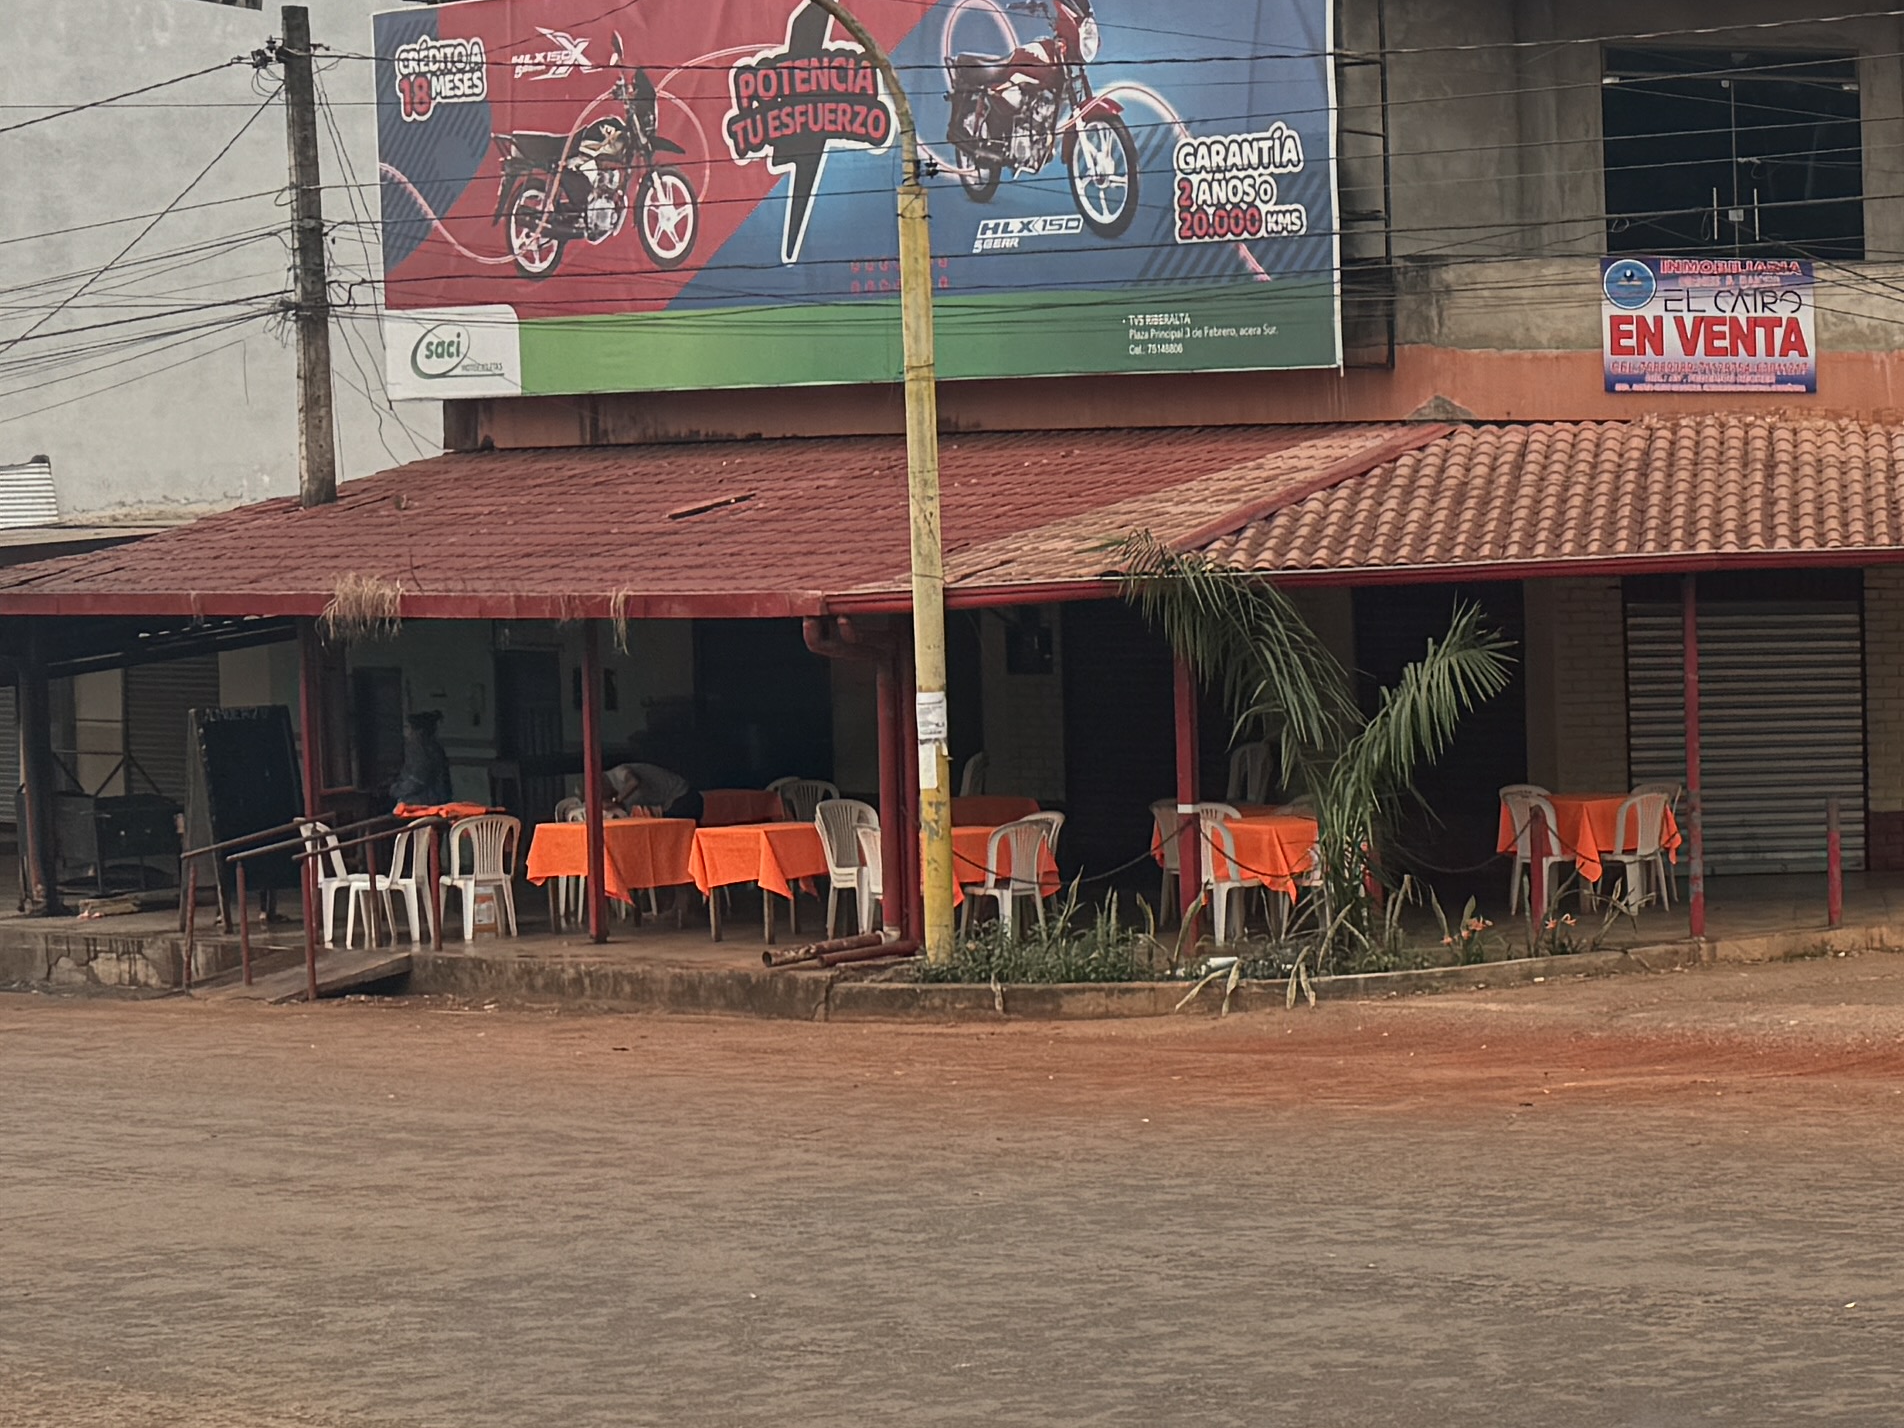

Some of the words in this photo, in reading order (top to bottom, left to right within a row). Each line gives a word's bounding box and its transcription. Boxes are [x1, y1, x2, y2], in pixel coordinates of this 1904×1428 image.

[399, 39, 468, 75] CRÉDITO
[398, 74, 432, 118] 18
[431, 71, 484, 99] MESES
[738, 56, 874, 108] POTENCIA
[732, 114, 764, 149] TU
[767, 103, 886, 139] ESFUERZO
[1178, 127, 1300, 174] GARANTÍA
[1178, 177, 1193, 208] 2
[1197, 172, 1257, 206] AÑOS
[980, 220, 1034, 236] HLX
[1180, 204, 1262, 239] 20.000
[1266, 209, 1303, 233] KMS
[1664, 289, 1706, 313] EL
[425, 332, 461, 360] saci
[1610, 315, 1664, 356] EN
[1674, 315, 1809, 358] VENTA
